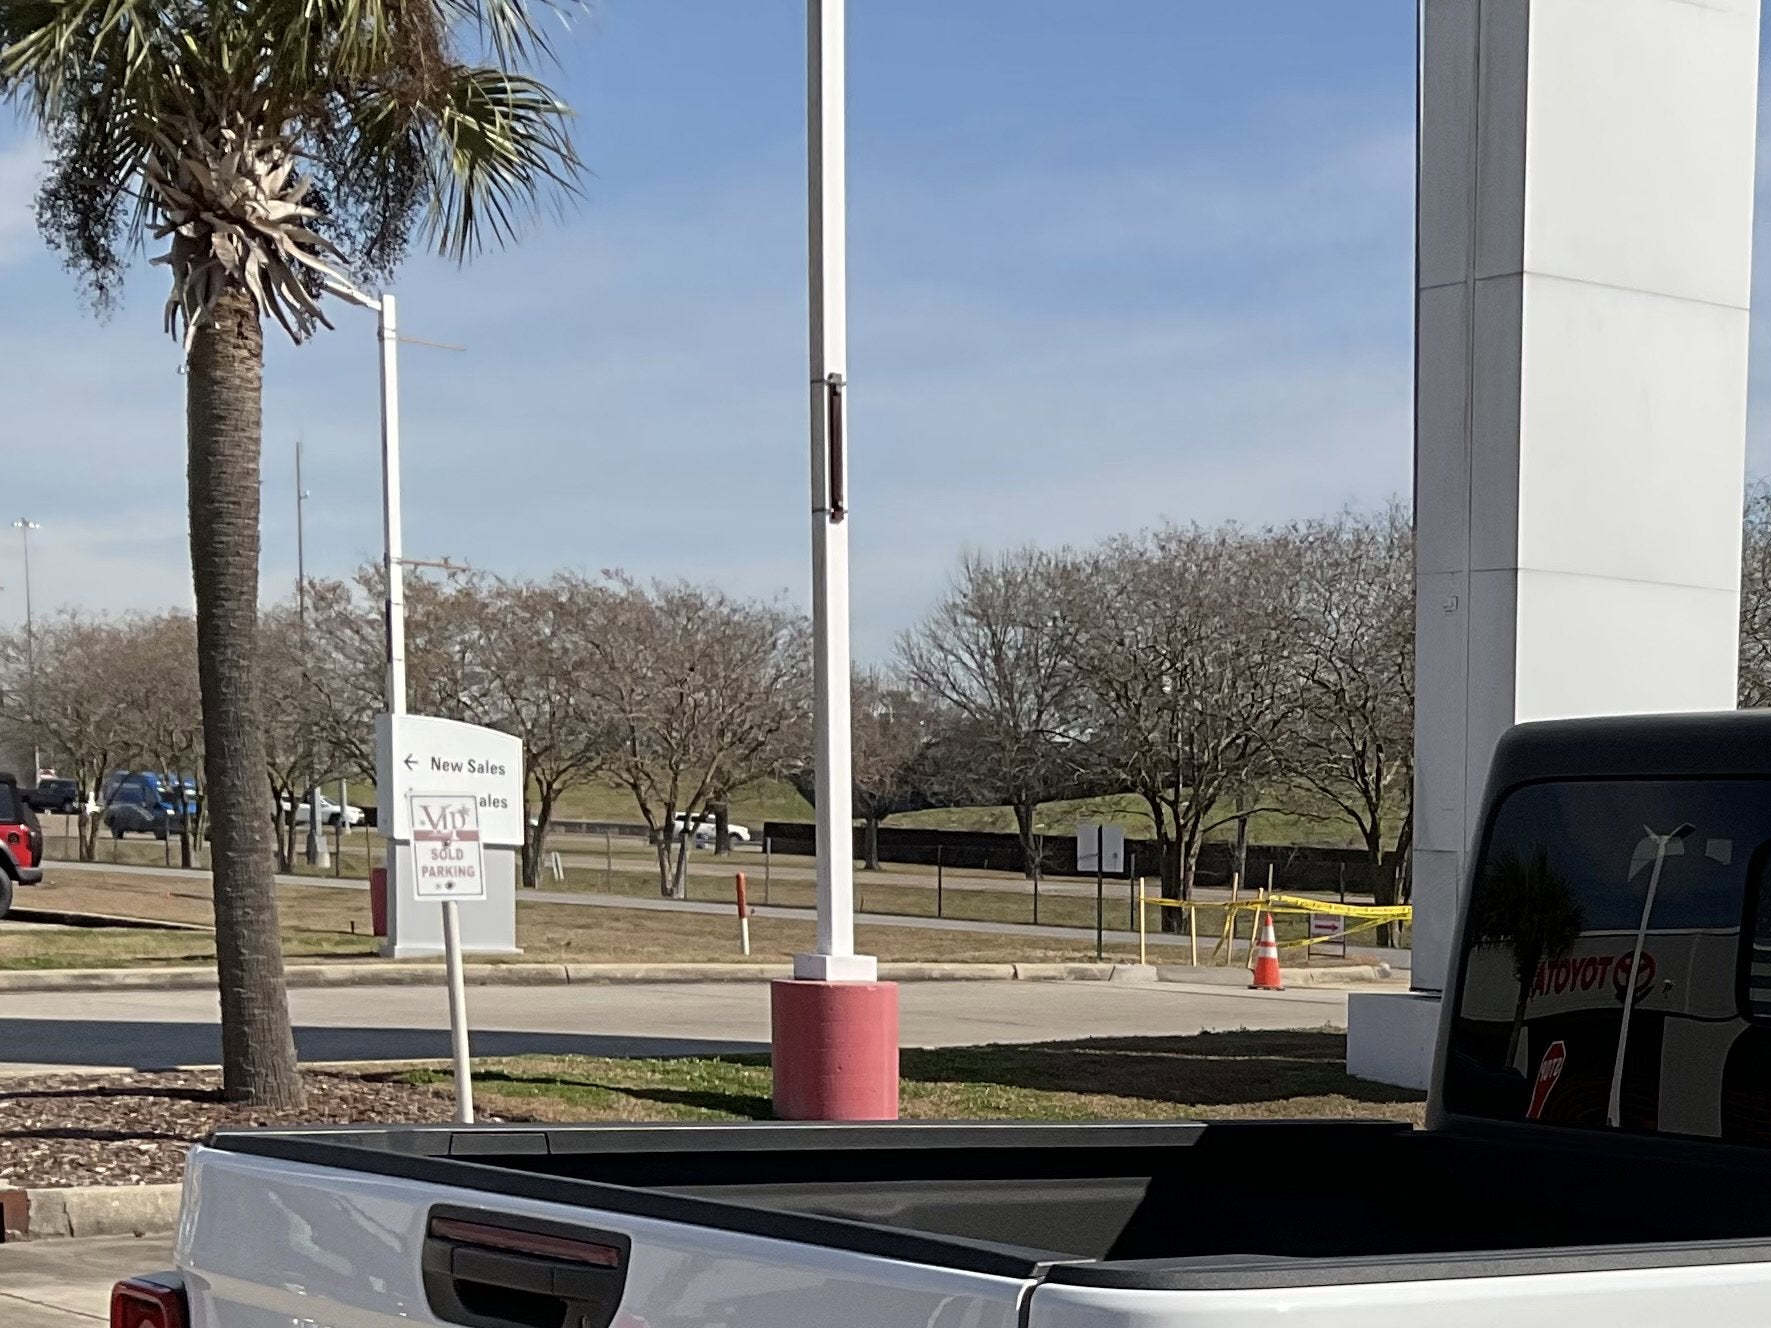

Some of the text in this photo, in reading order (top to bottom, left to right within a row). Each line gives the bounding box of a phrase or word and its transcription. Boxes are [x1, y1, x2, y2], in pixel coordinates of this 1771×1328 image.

[430, 756, 506, 776] New Sales
[479, 793, 508, 809] ales
[431, 848, 464, 861] SOLD
[421, 866, 476, 879] PARKING
